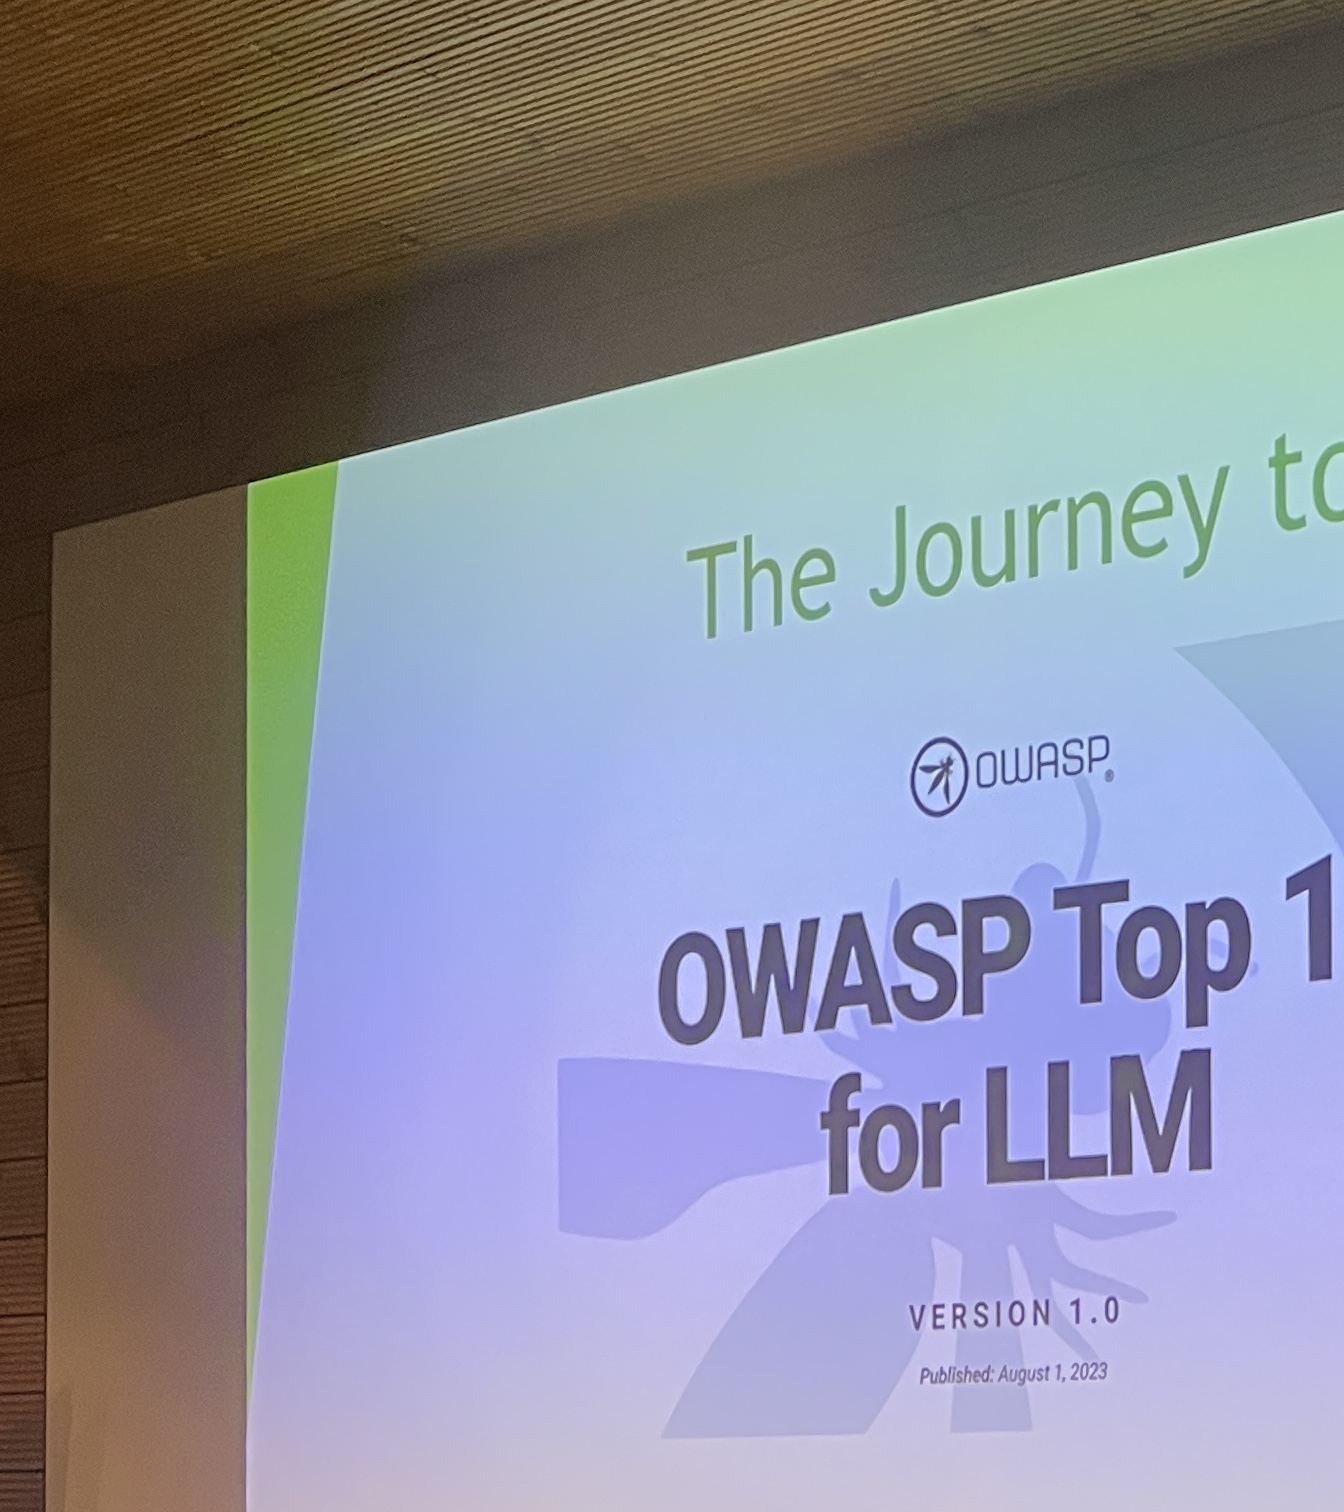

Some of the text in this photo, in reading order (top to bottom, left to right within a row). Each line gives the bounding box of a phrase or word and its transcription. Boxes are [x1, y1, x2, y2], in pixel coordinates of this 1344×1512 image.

[686, 533, 836, 640] The
[868, 464, 1231, 608] Journey
[658, 894, 1032, 1046] OWASP
[1052, 878, 1252, 1029] Top
[819, 1047, 1213, 1196] for LLM
[908, 1295, 1120, 1332] VERSION 1.0
[919, 1361, 1109, 1388] Published: August 1, 2023
